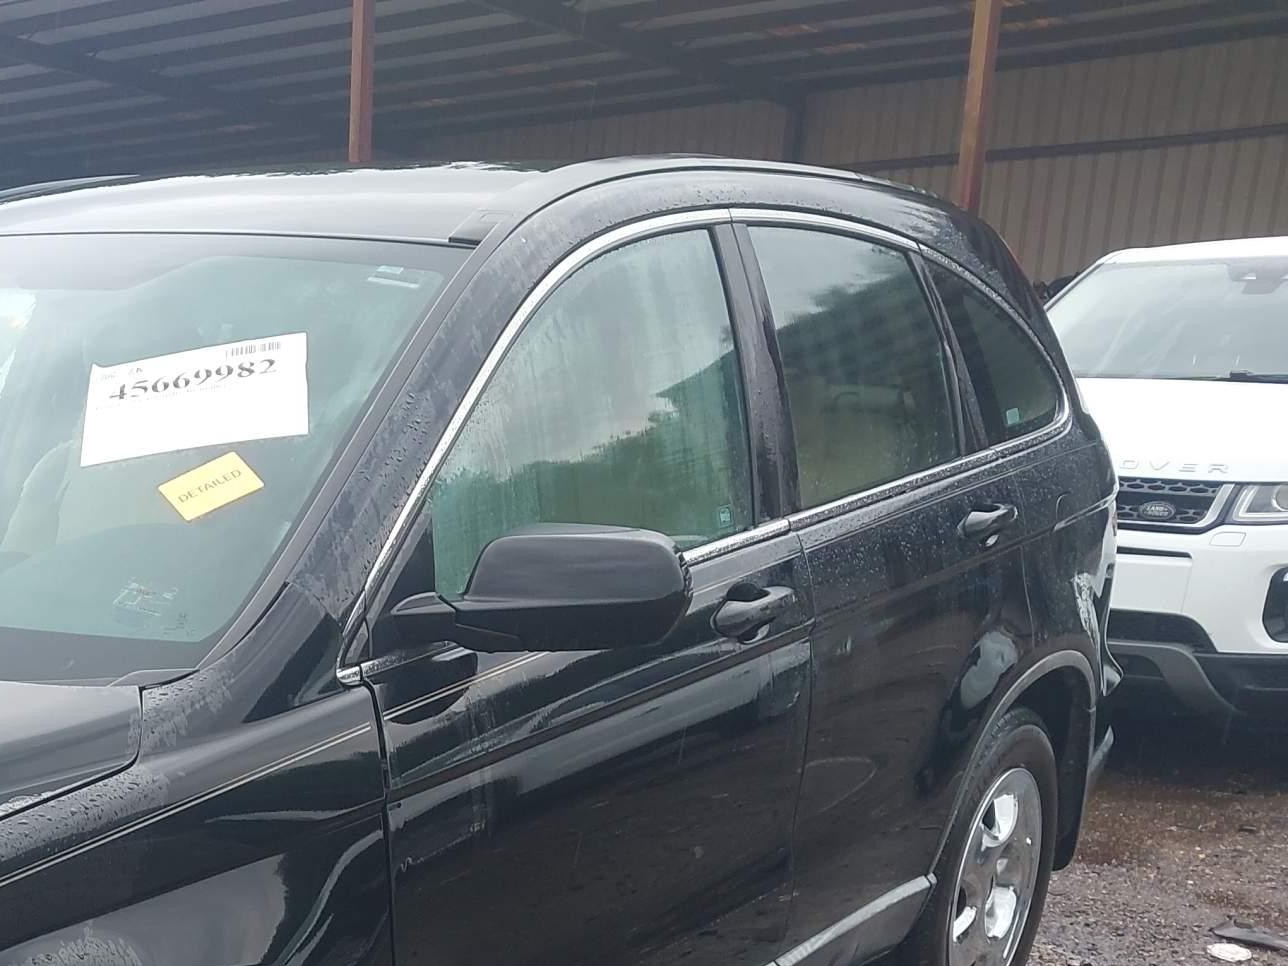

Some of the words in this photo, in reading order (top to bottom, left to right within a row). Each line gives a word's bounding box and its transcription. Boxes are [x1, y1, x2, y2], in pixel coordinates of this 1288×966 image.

[109, 358, 278, 400] 45669982
[1119, 459, 1229, 474] OVER
[177, 469, 242, 503] DETAILED
